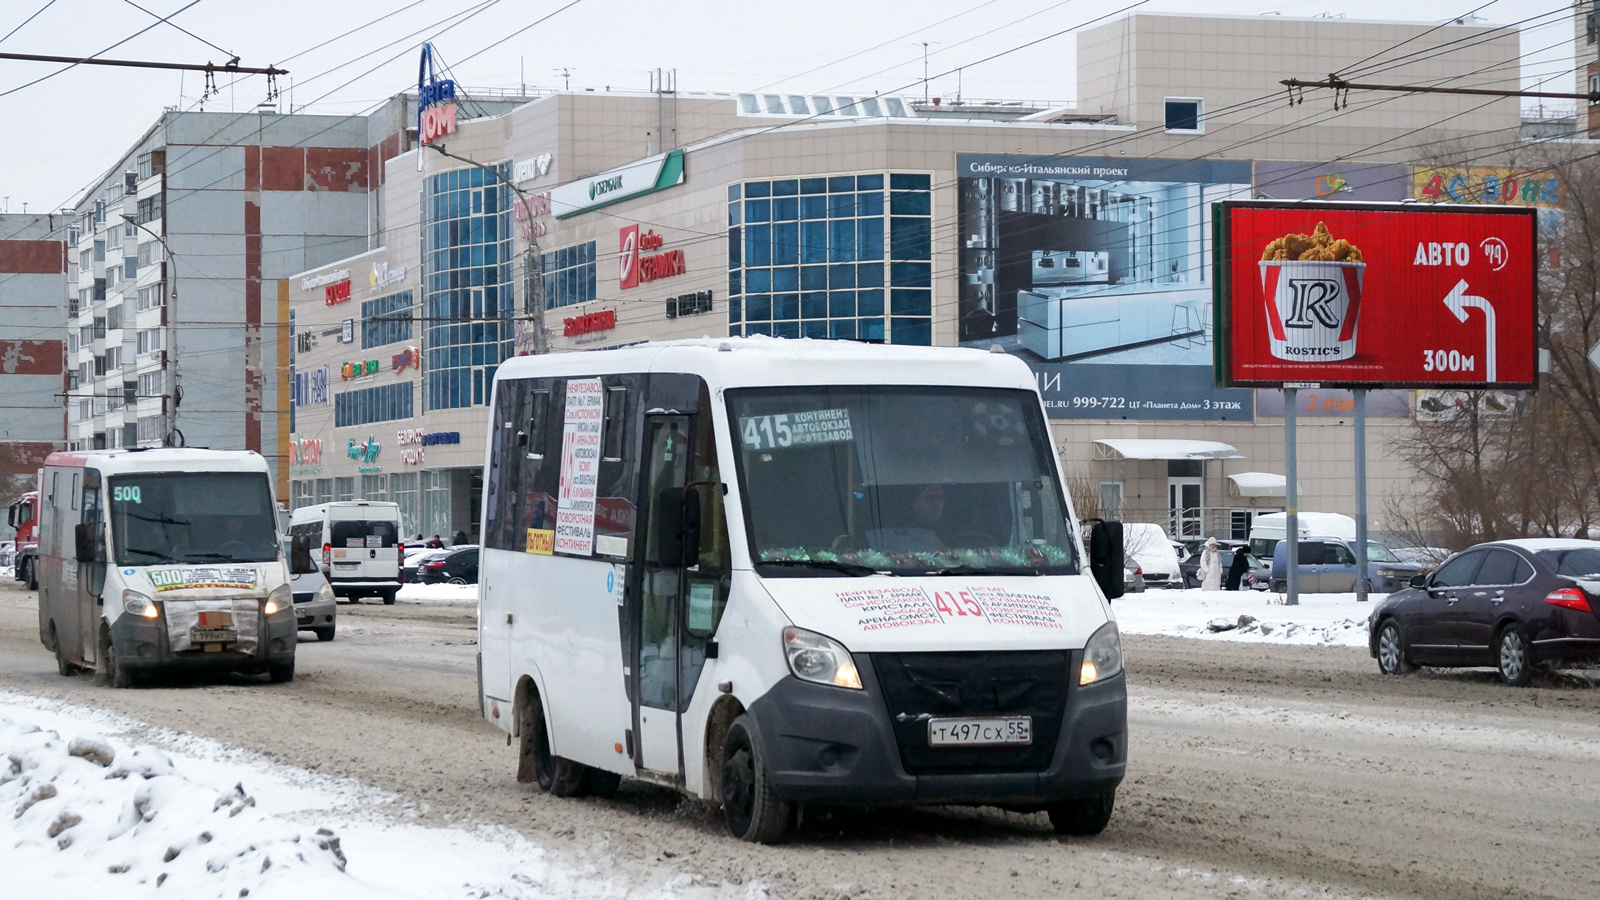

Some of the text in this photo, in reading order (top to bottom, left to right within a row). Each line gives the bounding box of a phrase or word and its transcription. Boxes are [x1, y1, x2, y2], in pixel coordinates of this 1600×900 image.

[970, 162, 1129, 178] Сибирско-Итальянский проект
[596, 174, 624, 196] СБЕРБАНК
[1421, 173, 1444, 200] 4
[1413, 242, 1470, 266] АВТО
[1285, 279, 1340, 329] R
[1285, 346, 1340, 356] ROSTIC'S
[1423, 350, 1475, 371] 300м
[1073, 396, 1125, 409] 999-722
[1142, 400, 1179, 410] «Планета
[1203, 399, 1211, 410] 3
[1213, 401, 1242, 411] этаж
[1307, 393, 1318, 410] 2
[743, 414, 793, 450] 415
[792, 419, 851, 434] АВТОВОКЗАЛ
[792, 430, 853, 443] НЕФТЕЗАВОД
[113, 485, 142, 502] 500
[558, 511, 593, 525] ПОВОРОТНАЯ
[557, 525, 592, 538] ФЕСТИВАЛЬ
[555, 537, 591, 551] КОНТИНЕНТ
[150, 569, 183, 586] 500
[835, 587, 921, 599] НЕФТЕЗАВОД
[839, 595, 865, 603] ПАТП
[890, 591, 923, 599] ЕРМАК
[861, 601, 932, 612] КРИСТАЛЛ
[933, 590, 983, 617] 415
[857, 612, 937, 625] АРЕНА-ОМСК
[985, 606, 1063, 618] ПОВОРОТНАЯ
[988, 611, 1056, 623] ФЕСТИВАЛЬ
[863, 618, 942, 632] АВТОВОКЗАЛ
[991, 617, 1063, 630] КОНТИНЕНТ
[1008, 721, 1024, 735] 55
